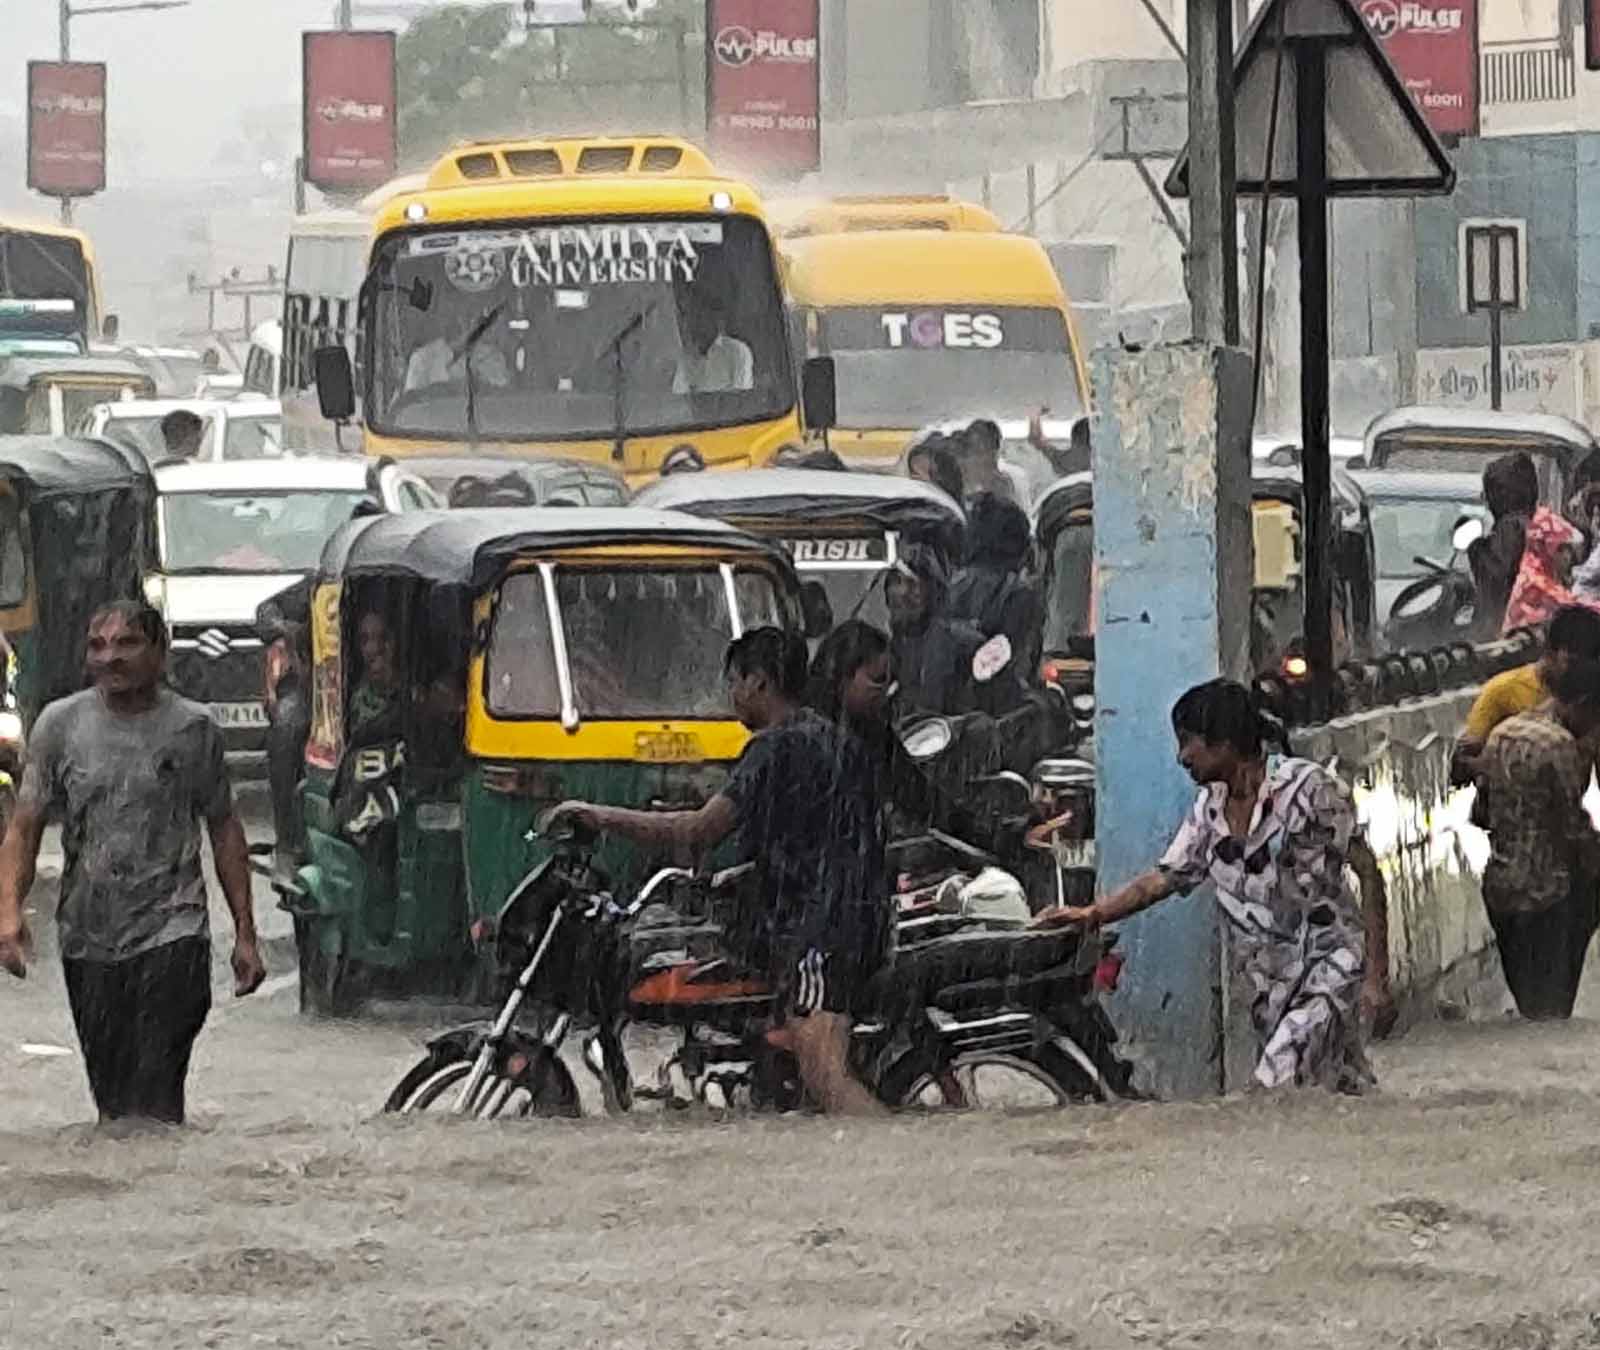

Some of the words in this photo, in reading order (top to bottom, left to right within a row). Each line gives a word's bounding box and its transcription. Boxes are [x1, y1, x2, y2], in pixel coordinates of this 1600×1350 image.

[1401, 8, 1462, 28] PULSE
[755, 37, 816, 57] PULSE
[513, 227, 699, 262] ATMIYA
[512, 257, 696, 287] UNIVERSITY
[881, 312, 1003, 348] TGES
